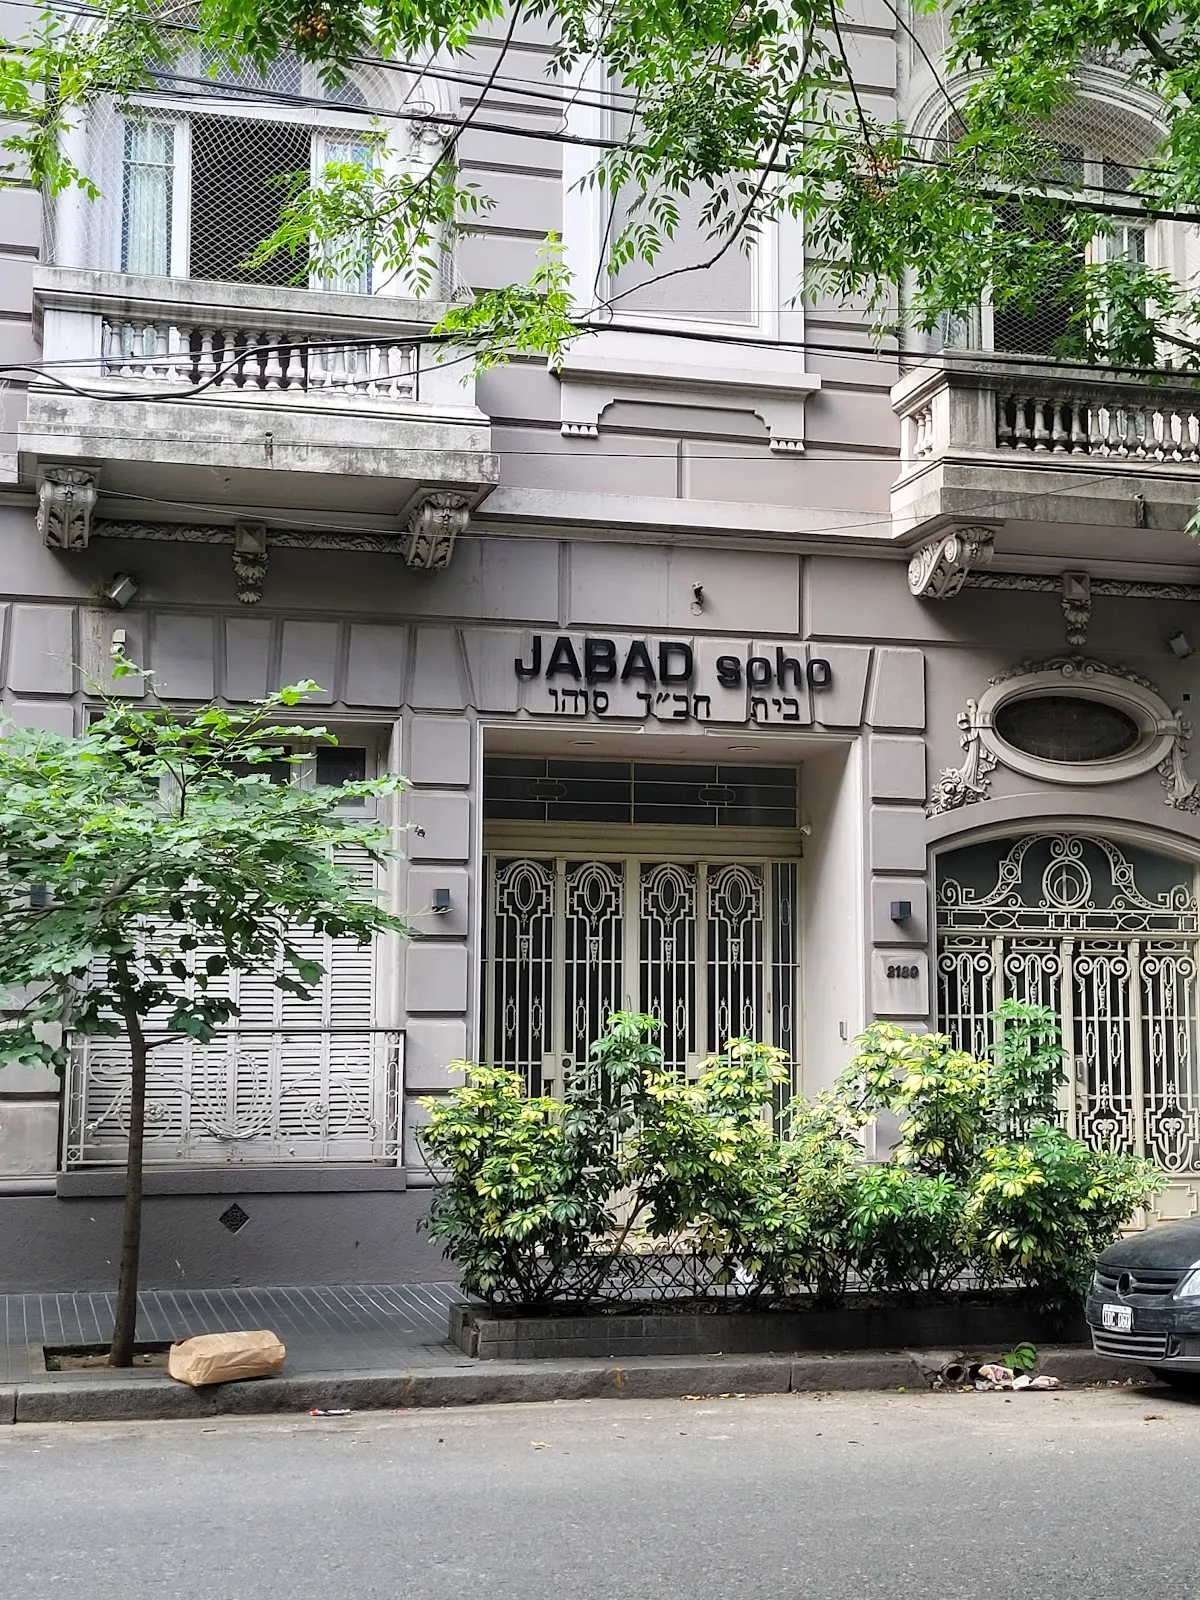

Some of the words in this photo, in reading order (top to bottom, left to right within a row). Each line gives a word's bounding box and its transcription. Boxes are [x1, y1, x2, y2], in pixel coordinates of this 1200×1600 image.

[514, 635, 693, 683] JABAD
[716, 647, 831, 687] soho
[548, 688, 609, 714] סוהו
[750, 696, 801, 721] בית
